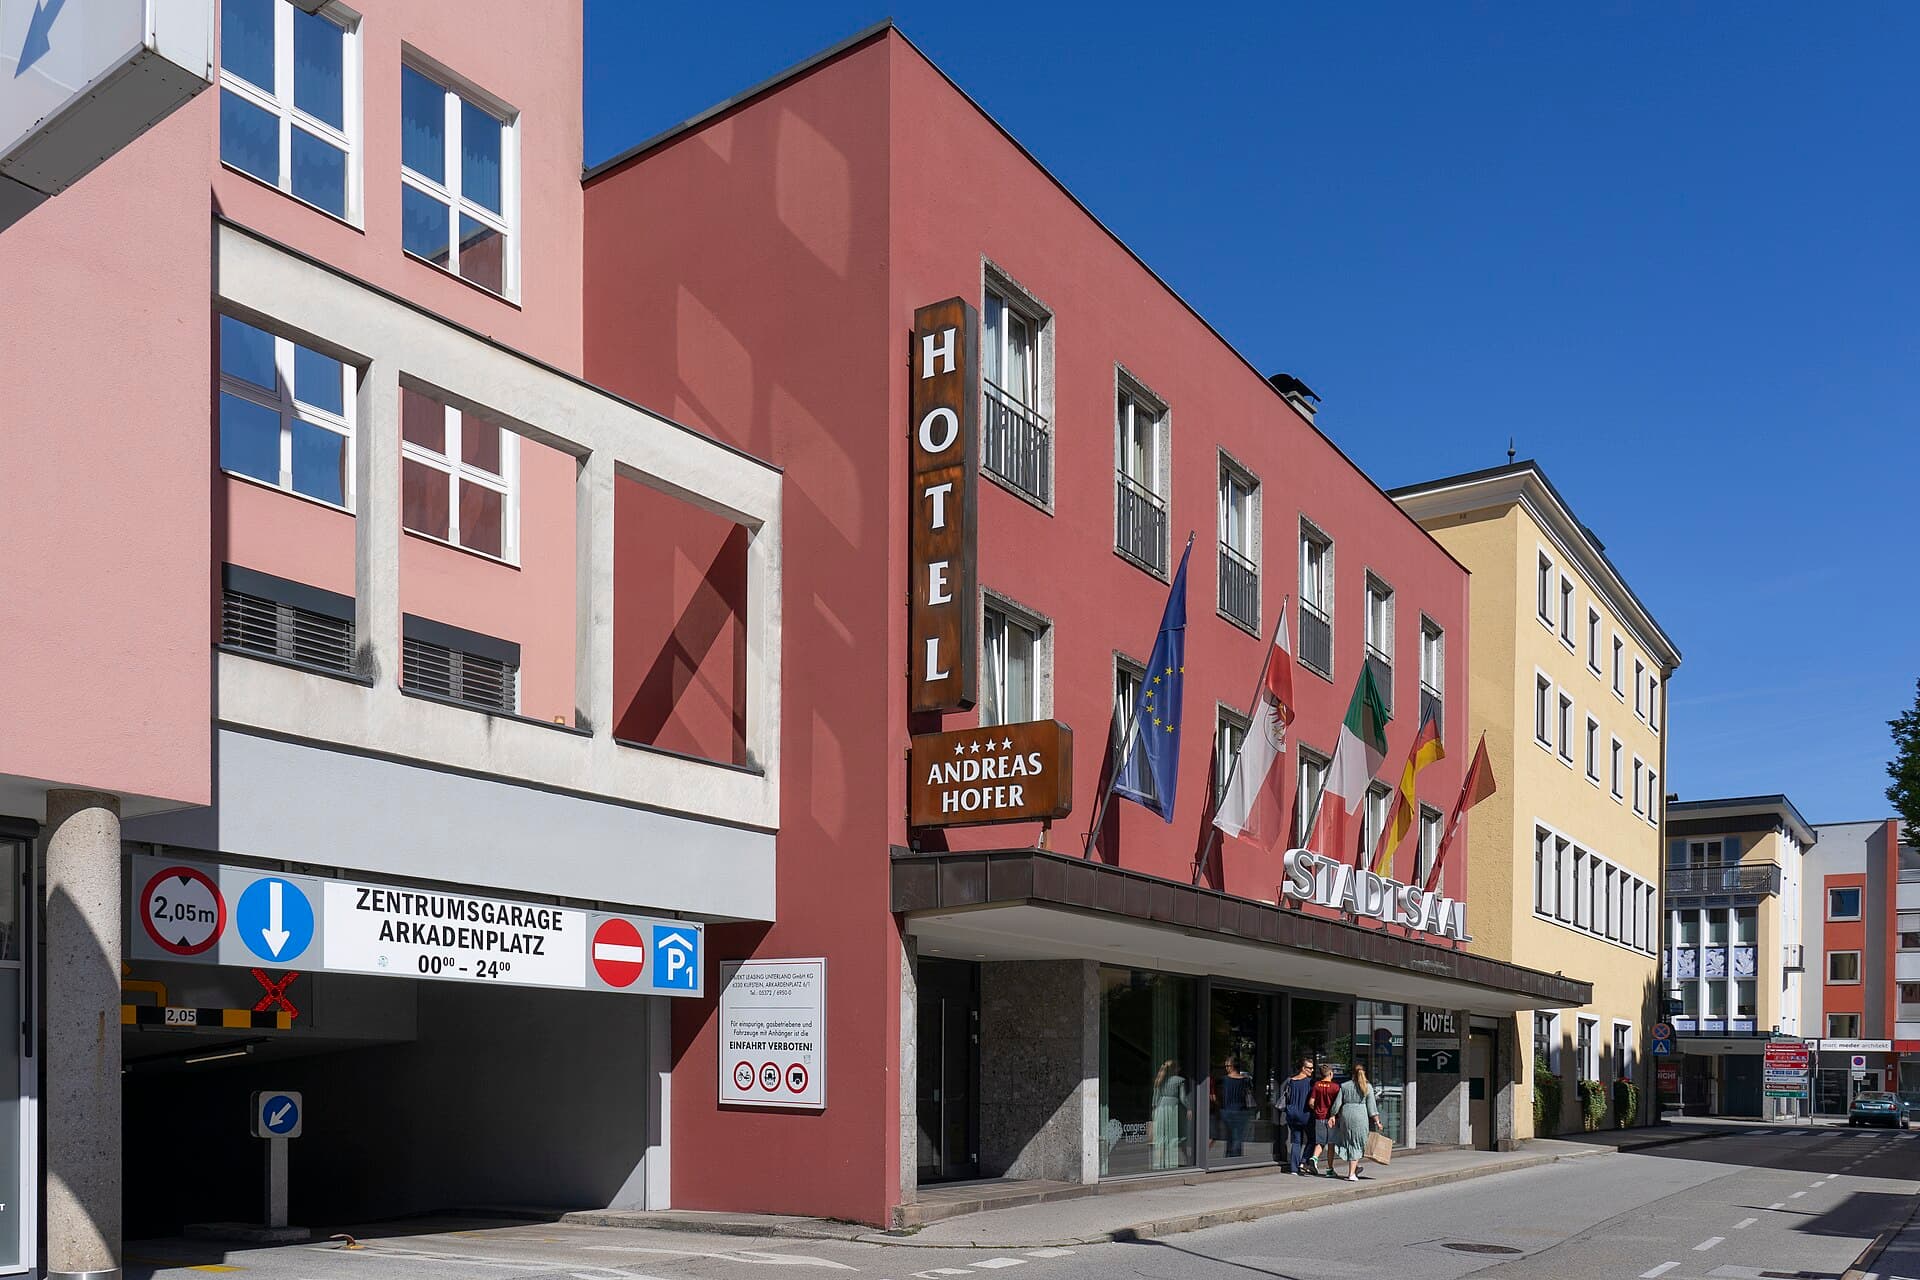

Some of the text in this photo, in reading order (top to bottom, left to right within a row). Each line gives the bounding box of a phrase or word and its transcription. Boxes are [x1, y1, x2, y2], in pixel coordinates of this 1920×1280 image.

[918, 328, 958, 682] HOTEL
[927, 752, 1042, 785] ANDREAS
[942, 785, 1024, 812] HOFER
[1283, 848, 1472, 942] STADTSAAL
[356, 888, 563, 931] ZENTRUMSGARAGE
[379, 920, 544, 956] ARKADENPLATZ
[166, 1009, 195, 1023] 2,05
[766, 1020, 801, 1028] gasbetriebene
[1424, 1012, 1455, 1033] HOTEL
[734, 1029, 758, 1037] Fahrzeuge
[768, 1030, 792, 1038] Anhänger
[730, 1041, 812, 1051] EINFAHRT VERBOTEN!
[1437, 1056, 1447, 1069] P
